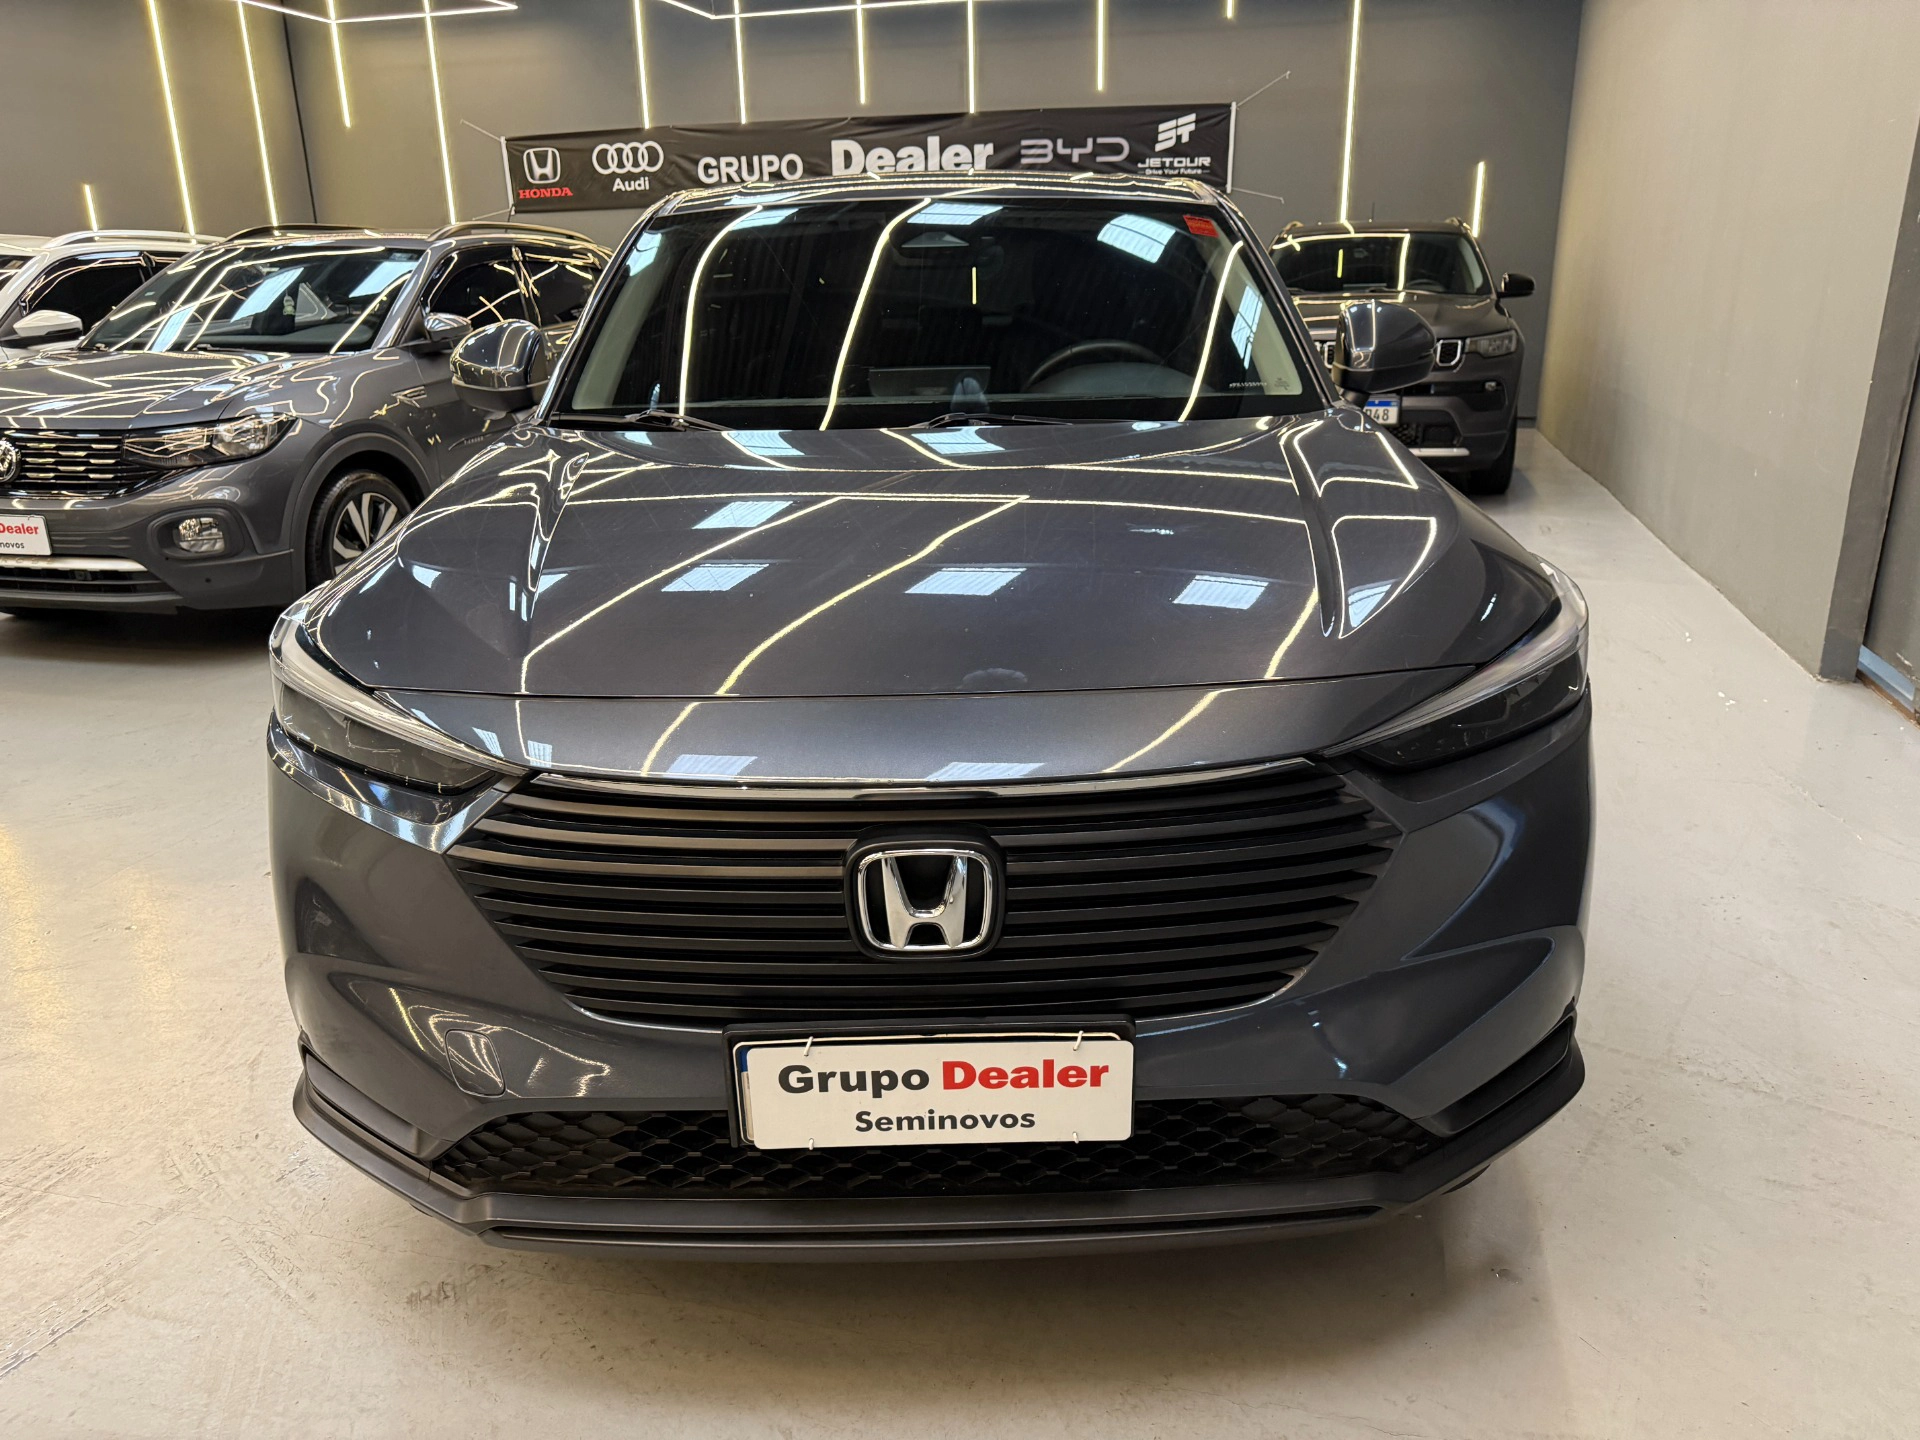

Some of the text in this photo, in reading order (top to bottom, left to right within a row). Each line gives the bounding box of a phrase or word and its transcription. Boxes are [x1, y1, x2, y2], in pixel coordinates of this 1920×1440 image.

[697, 135, 994, 185] GRUPO Dealer
[1020, 137, 1130, 165] BYD
[1137, 156, 1212, 168] JETOUR
[518, 187, 574, 199] HONDA
[612, 176, 650, 193] Audi
[778, 1059, 1110, 1099] Grupo Dealer
[855, 1109, 1036, 1133] Seminovos
